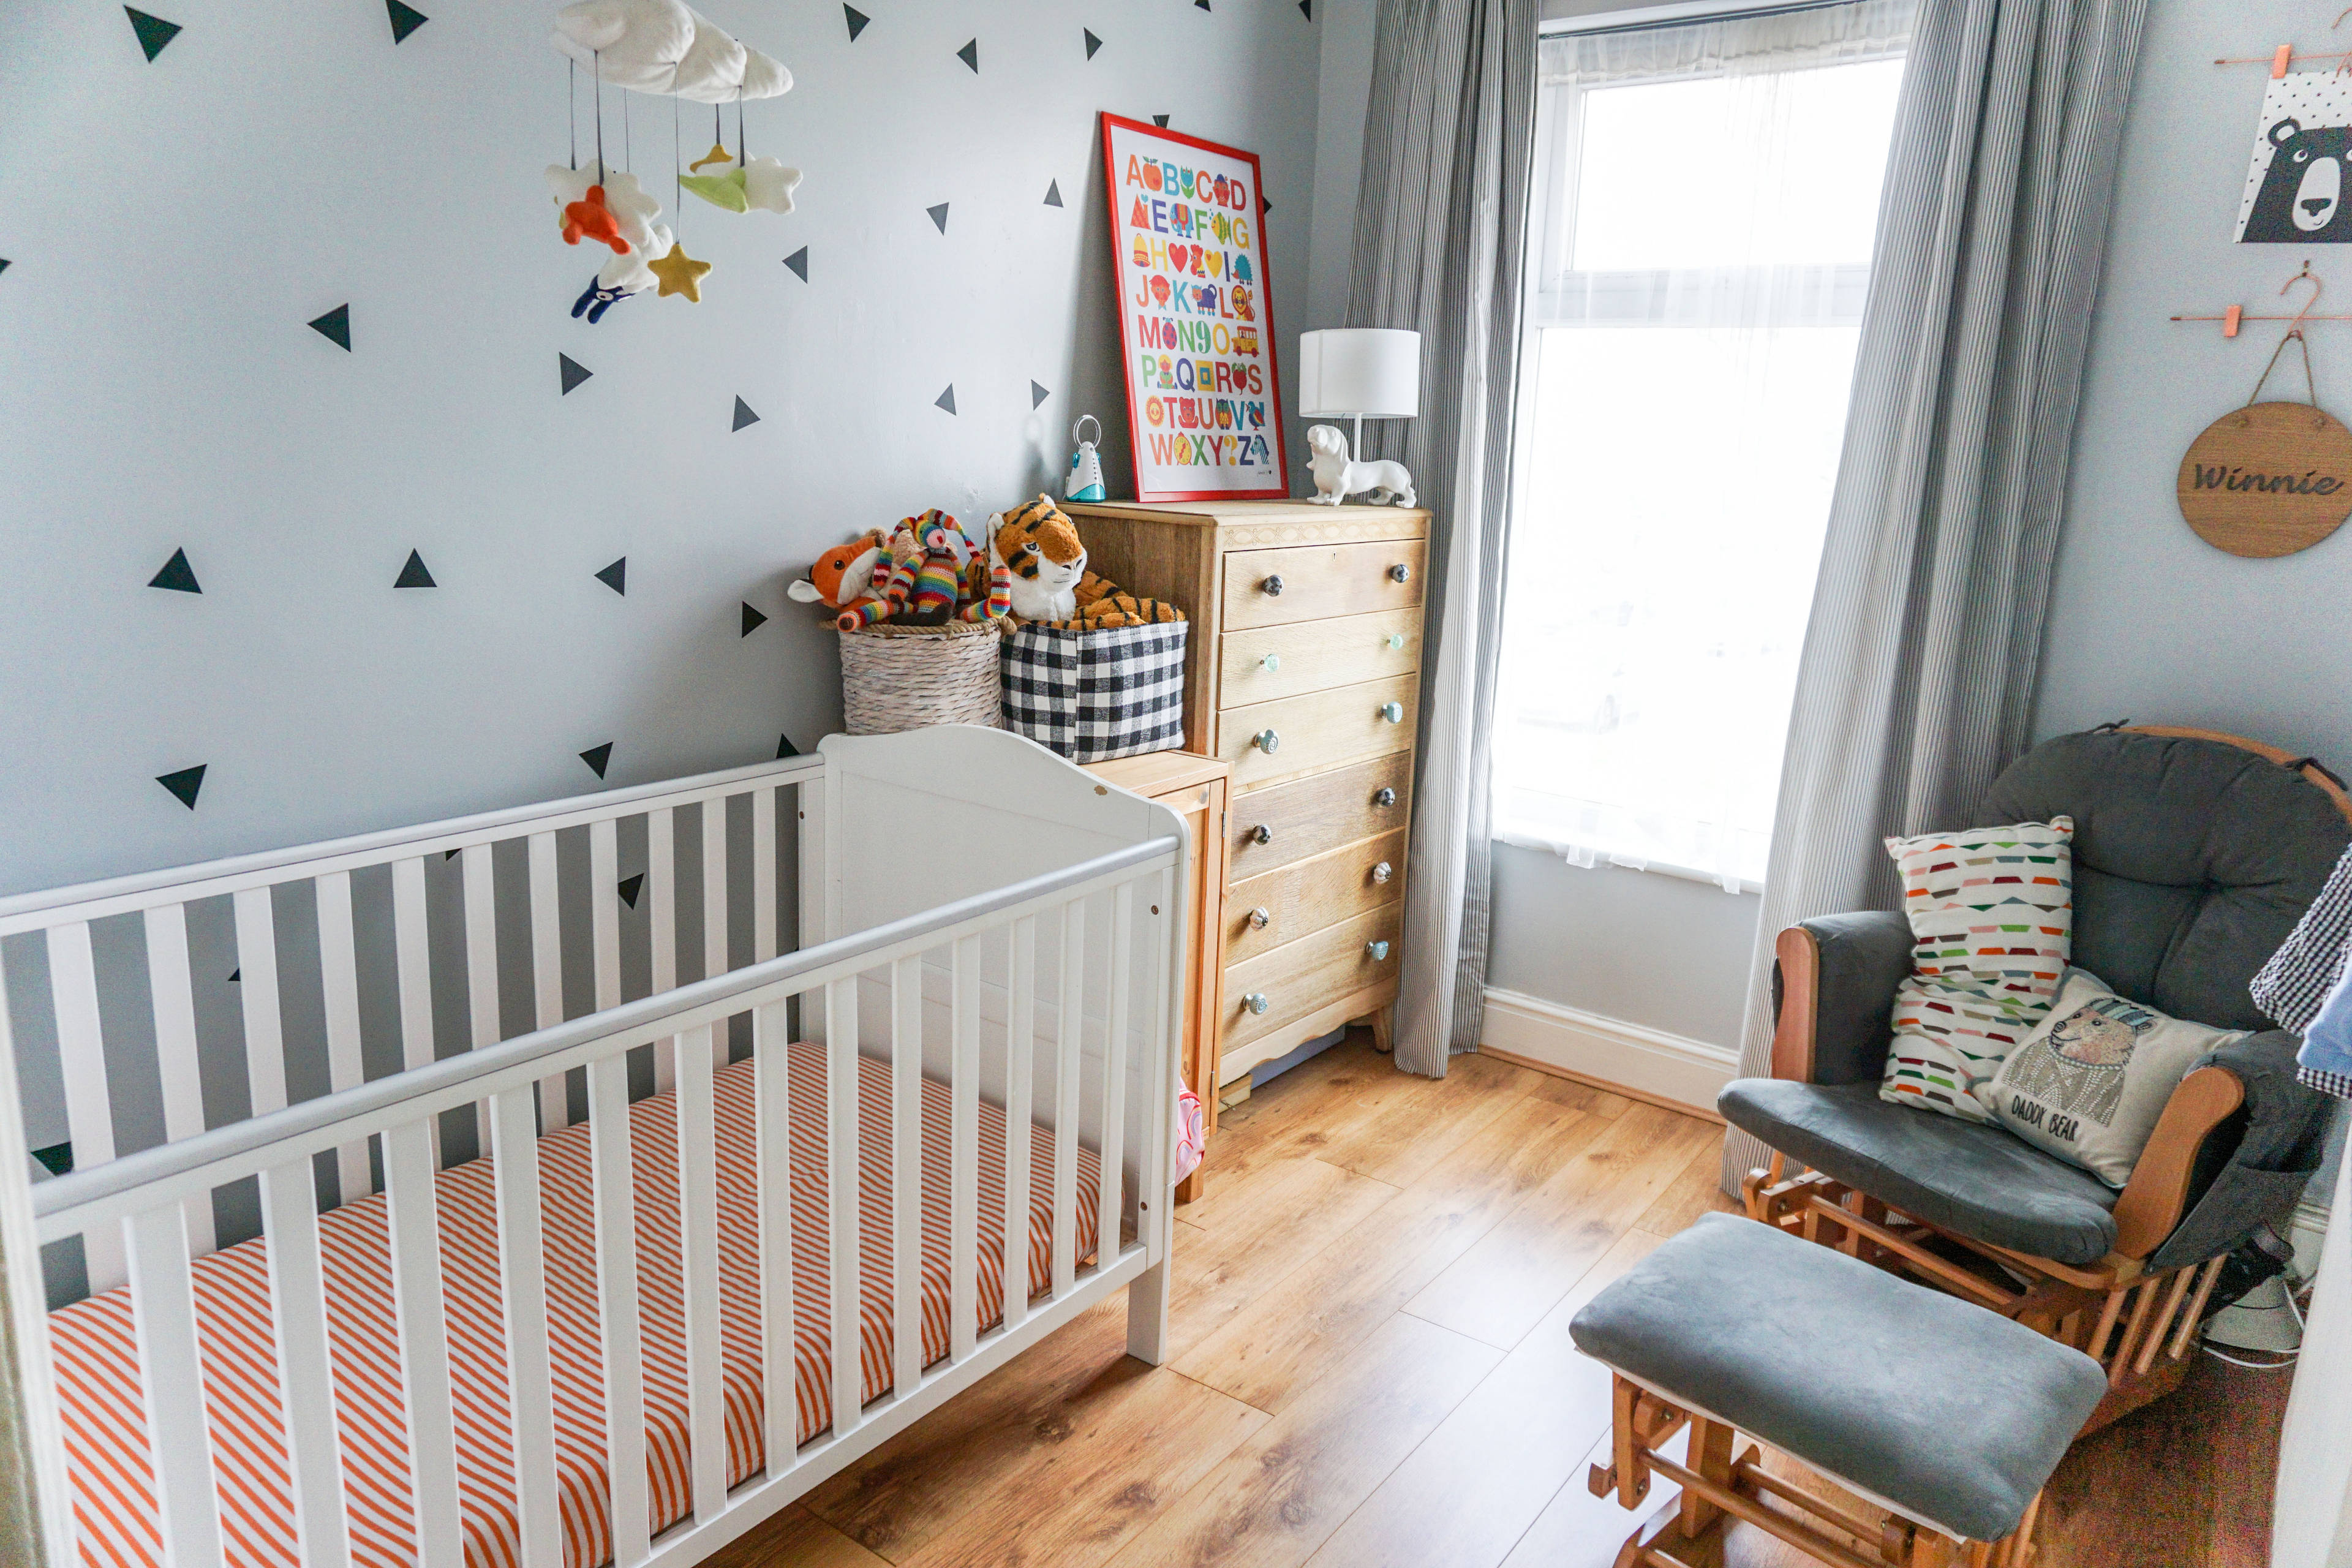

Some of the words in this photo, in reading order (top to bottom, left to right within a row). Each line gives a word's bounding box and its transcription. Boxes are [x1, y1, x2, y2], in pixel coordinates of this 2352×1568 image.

[2194, 463, 2345, 495] Winnie
[2011, 1095, 2047, 1128] DADDY
[2048, 1112, 2079, 1142] BEAR
